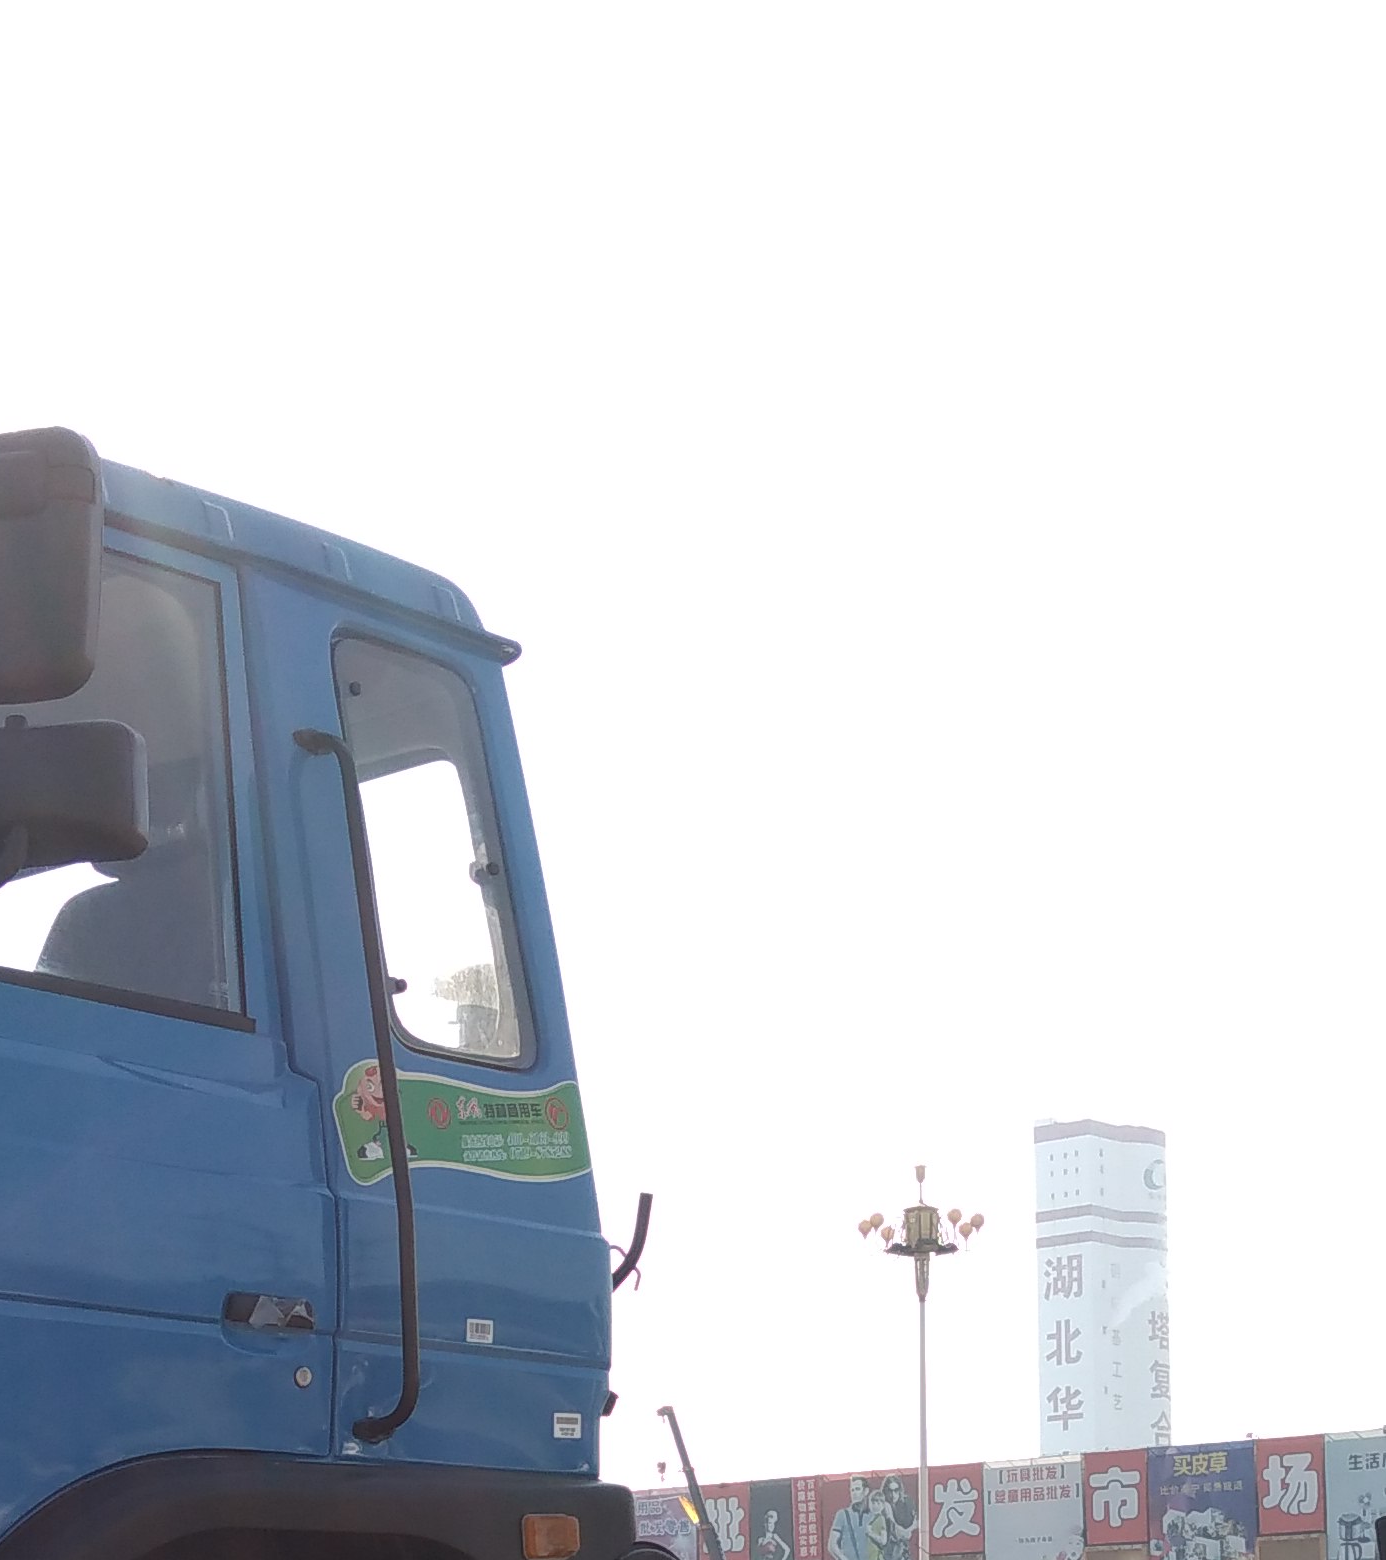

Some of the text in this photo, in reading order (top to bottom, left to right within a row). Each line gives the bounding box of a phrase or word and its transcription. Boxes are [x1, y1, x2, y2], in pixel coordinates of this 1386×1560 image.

[1173, 1452, 1228, 1476] 买皮草
[1263, 1453, 1318, 1516] 场
[932, 1479, 981, 1538] 发
[1089, 1466, 1141, 1528] 市
